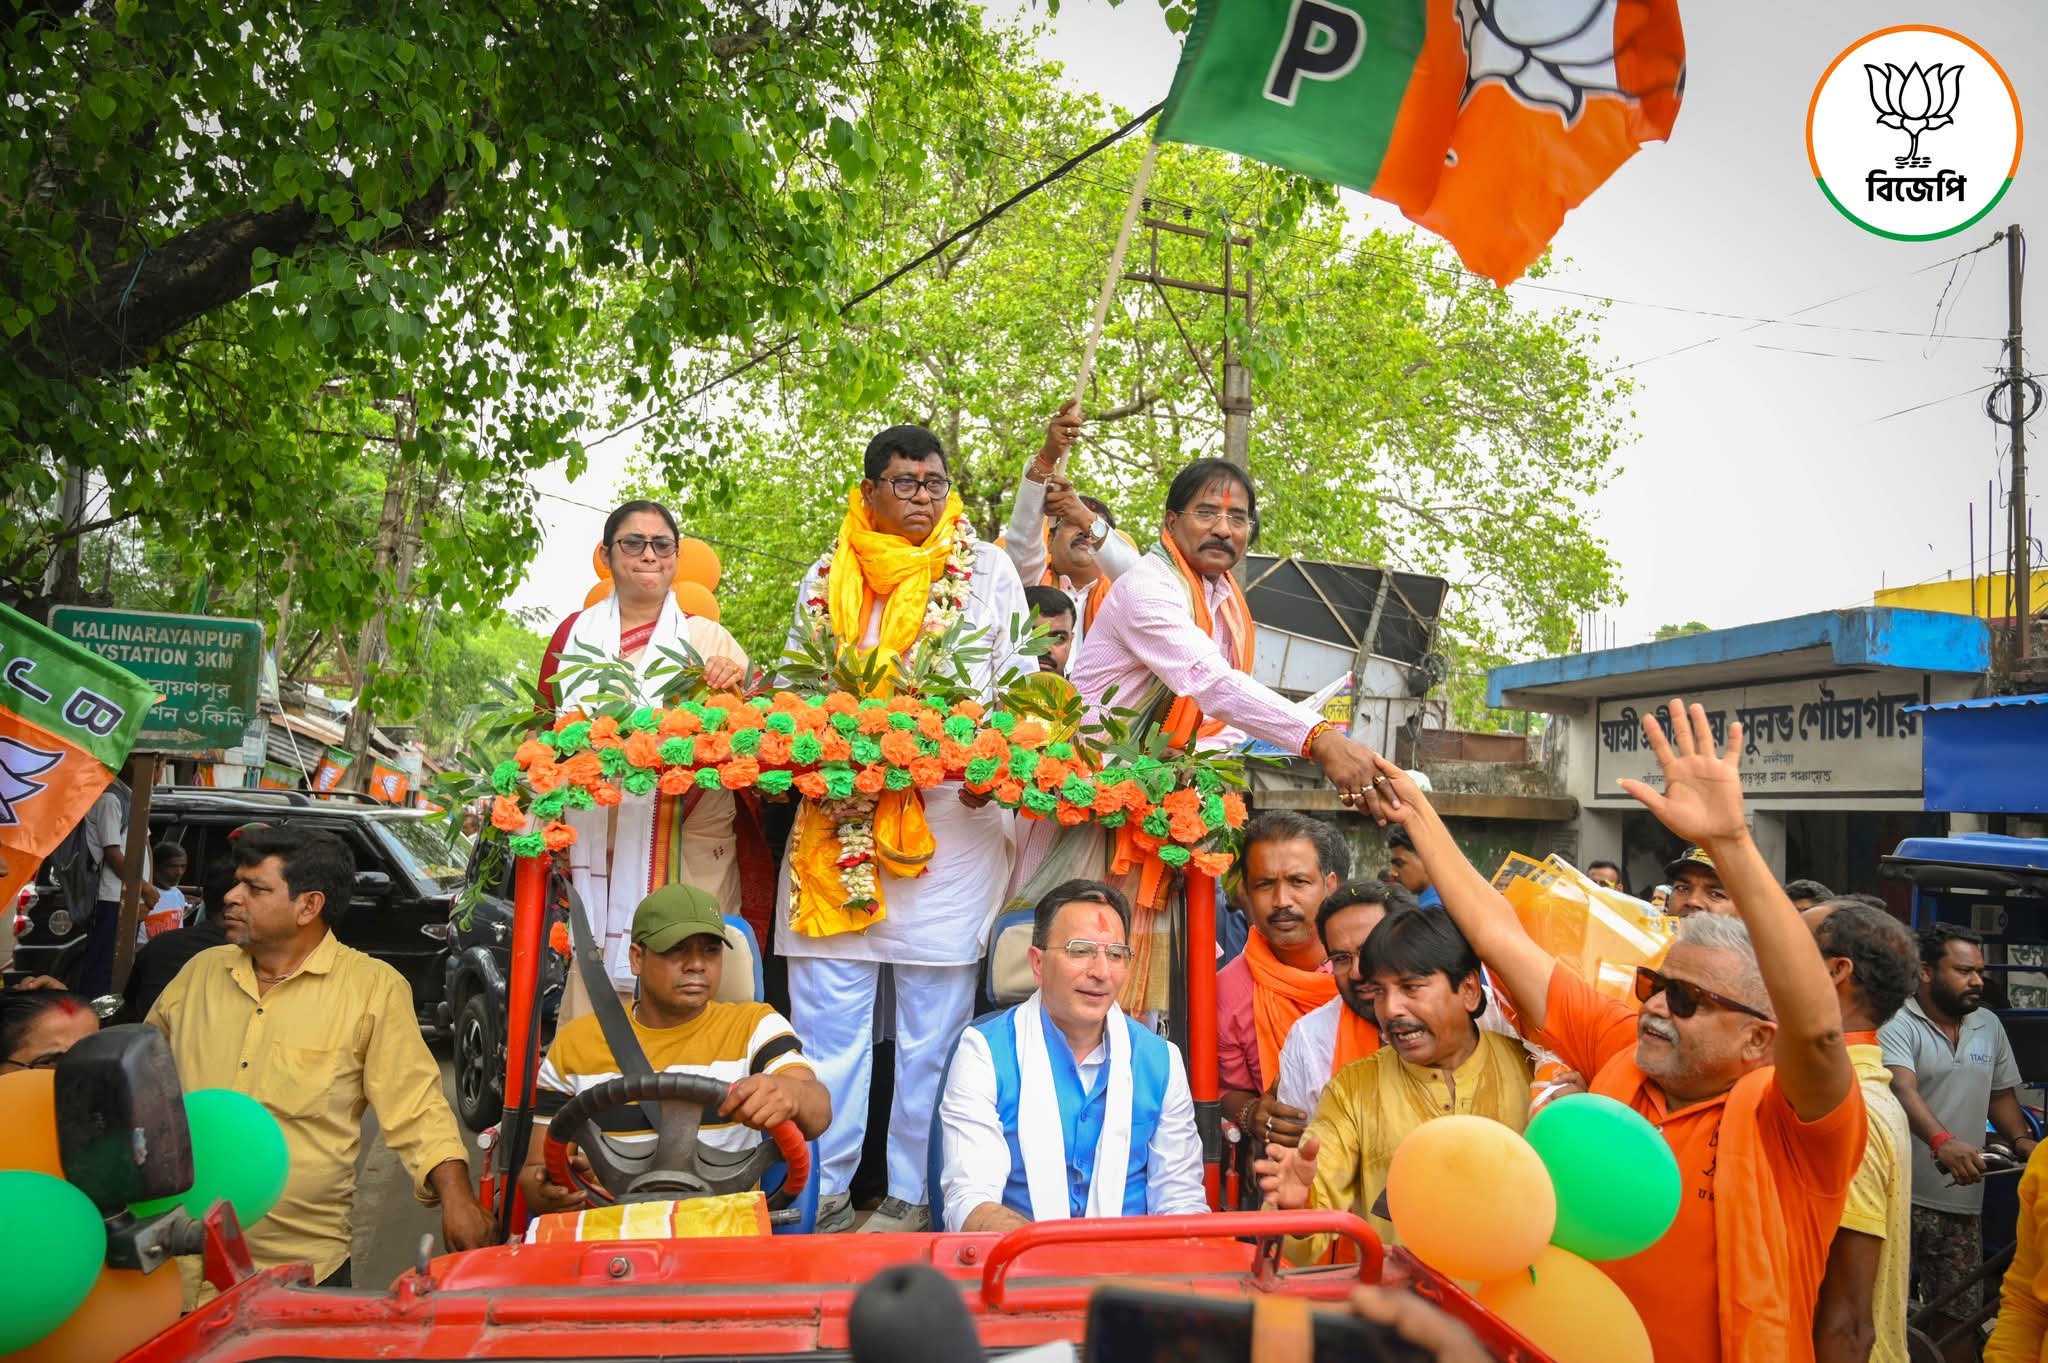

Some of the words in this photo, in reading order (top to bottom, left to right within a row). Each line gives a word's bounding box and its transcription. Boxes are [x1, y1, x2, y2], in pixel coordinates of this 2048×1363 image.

[72, 621, 243, 649] KALINARAYANPUR
[79, 641, 188, 666] YSTATION
[194, 651, 233, 669] 3KM
[1600, 706, 1640, 753] যাত্রী
[1798, 680, 1921, 742] শৌচাগার
